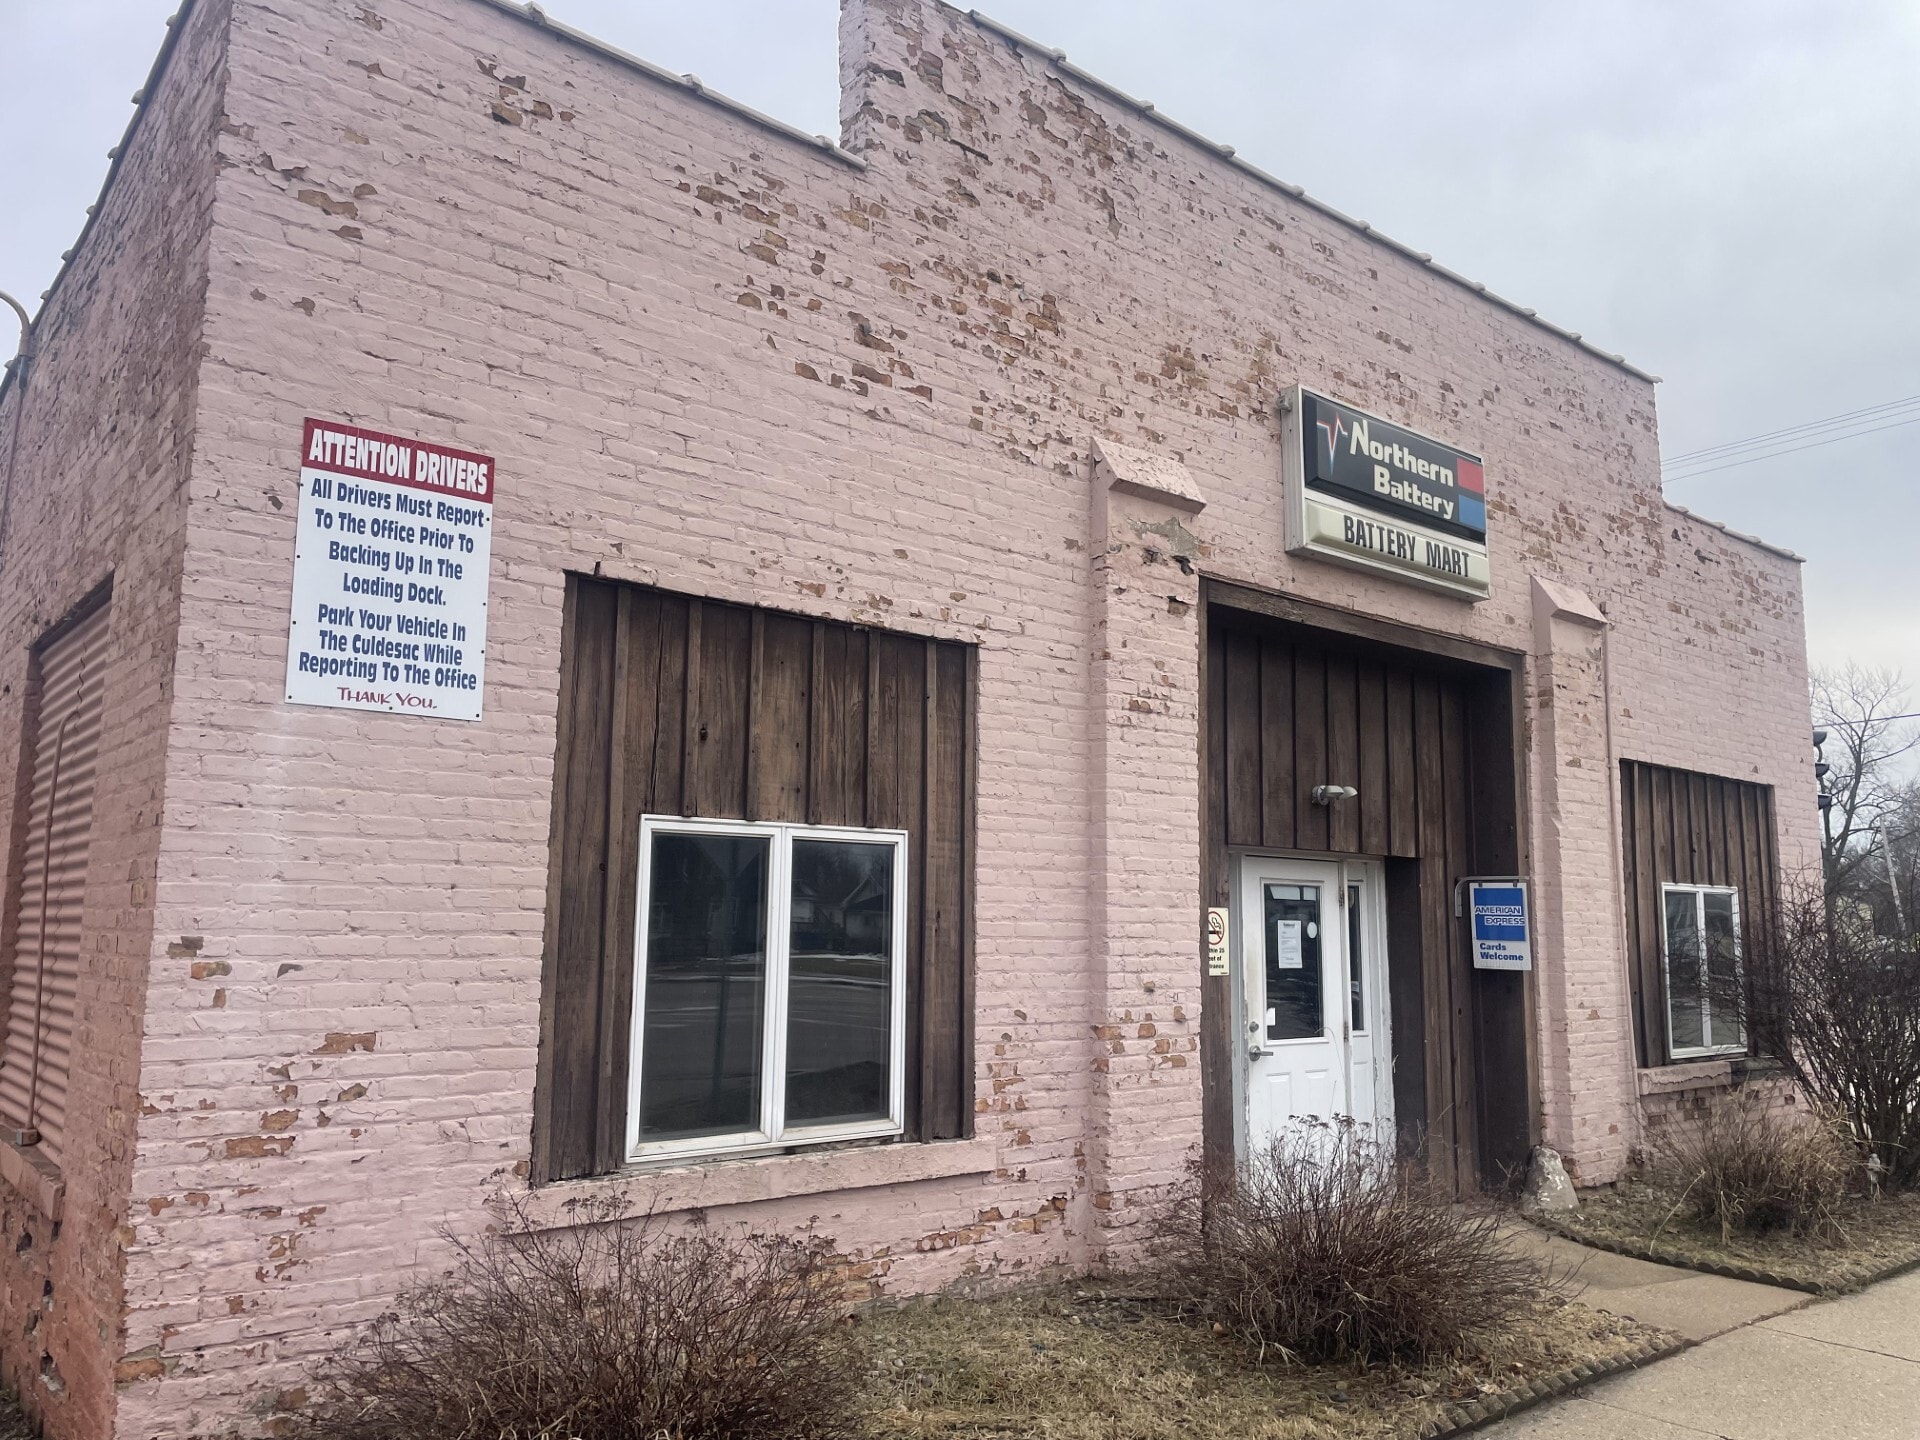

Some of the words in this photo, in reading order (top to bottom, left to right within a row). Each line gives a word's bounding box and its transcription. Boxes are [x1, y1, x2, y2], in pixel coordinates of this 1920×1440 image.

[309, 428, 411, 479] ATTENTION
[415, 449, 488, 495] DRIVERS
[1350, 419, 1454, 487] Northern
[311, 478, 332, 500] All
[337, 482, 391, 510] Drivers
[396, 493, 432, 517] Must
[436, 501, 484, 528] Report
[1373, 464, 1454, 520] Battery
[315, 508, 333, 529] To
[338, 511, 366, 535] The
[370, 517, 415, 544] Office
[419, 526, 454, 550] Prior
[458, 533, 474, 553] To
[1343, 514, 1416, 562] BATTERY
[1426, 540, 1469, 578] MART
[329, 540, 390, 572] Backing
[395, 551, 414, 575] Up
[419, 555, 433, 576] In
[437, 558, 463, 580] The
[343, 572, 403, 603] Loading
[407, 582, 447, 606] Dock.
[317, 603, 354, 627] Park
[359, 608, 392, 632] Your
[396, 614, 448, 640] Vehicle
[452, 622, 466, 642] In
[319, 629, 347, 652] The
[352, 632, 419, 661] Culdesac
[423, 642, 463, 666] While
[299, 651, 377, 683] Reporting
[382, 661, 400, 682] To
[403, 664, 430, 685] The
[434, 667, 477, 690] Office
[337, 686, 393, 705] THANK
[1474, 906, 1521, 915] AMERICAN
[1485, 916, 1525, 926] EXPRESS
[1479, 942, 1507, 951] Cards
[1479, 951, 1524, 961] Welcome
